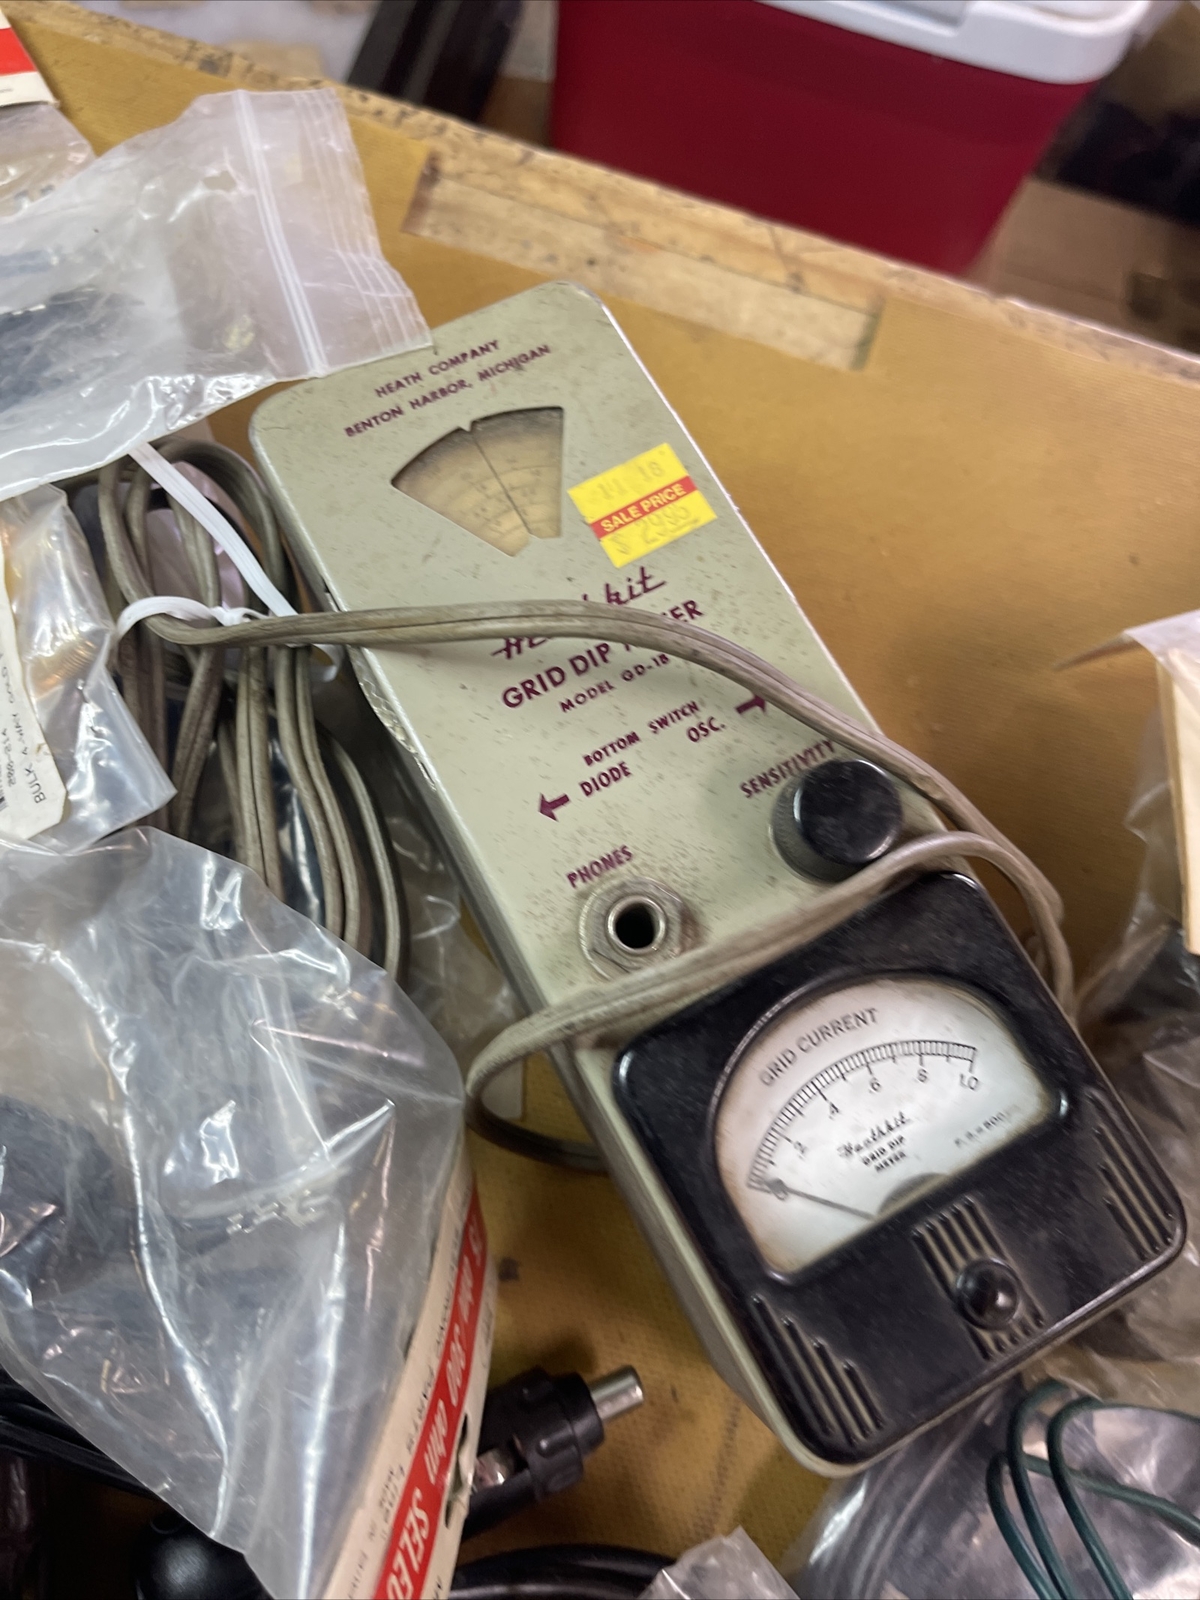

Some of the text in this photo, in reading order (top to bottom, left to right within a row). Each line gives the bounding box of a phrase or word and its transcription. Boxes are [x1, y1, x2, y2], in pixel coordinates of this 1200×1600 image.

[345, 345, 552, 437] BENTON HARBOR, MICHIGAN
[375, 340, 500, 398] HEATH COMPANY
[600, 482, 687, 532] SALE PRICE
[502, 642, 611, 709] GRID DIP
[559, 680, 616, 713] MODEL
[583, 701, 700, 767] BOTTOM SWITCH
[686, 716, 726, 743] OSC.
[25, 763, 47, 804] BULK
[579, 762, 632, 797] DIODE
[740, 740, 837, 798] SENSITIVITY
[566, 845, 634, 889] PHONES
[759, 1007, 877, 1086] GRID CURRENT
